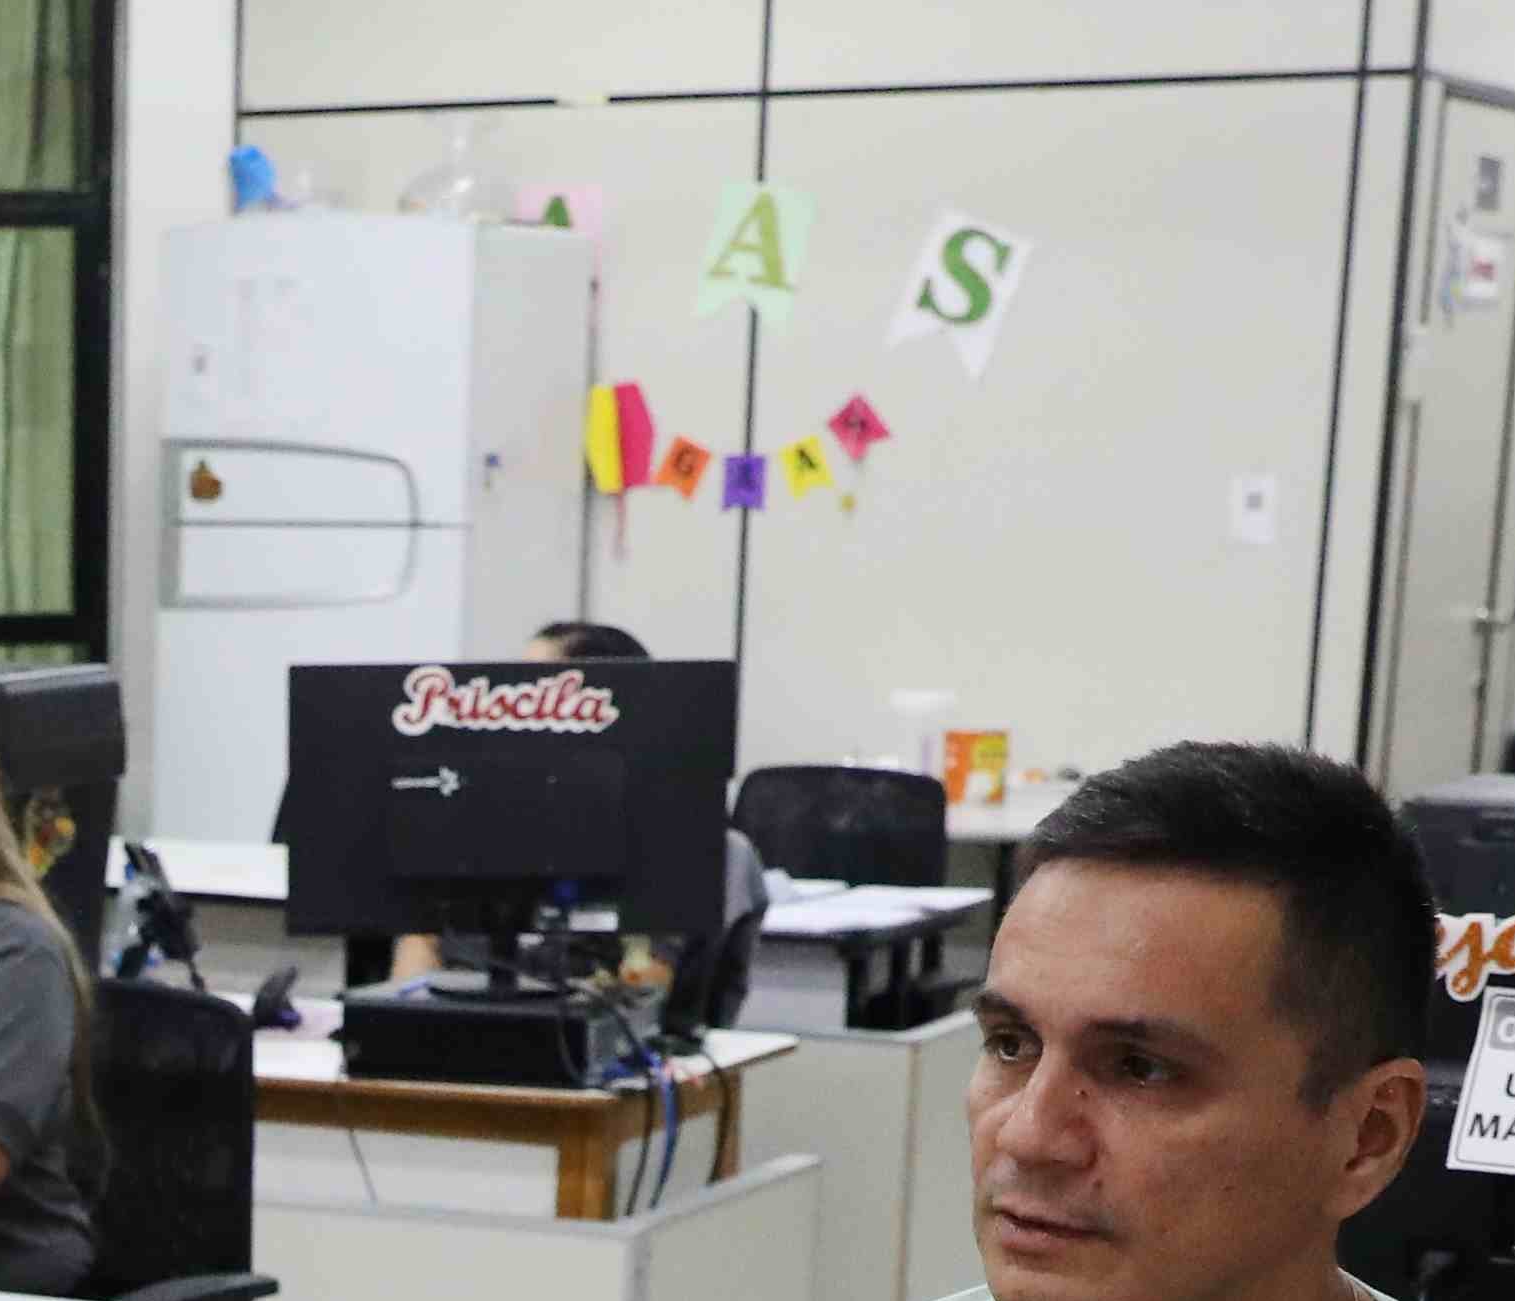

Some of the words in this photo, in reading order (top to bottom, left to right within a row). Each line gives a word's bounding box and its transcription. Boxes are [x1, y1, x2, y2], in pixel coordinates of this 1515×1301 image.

[707, 191, 795, 292] A
[916, 227, 1012, 327] S
[394, 667, 618, 734] Priscila
